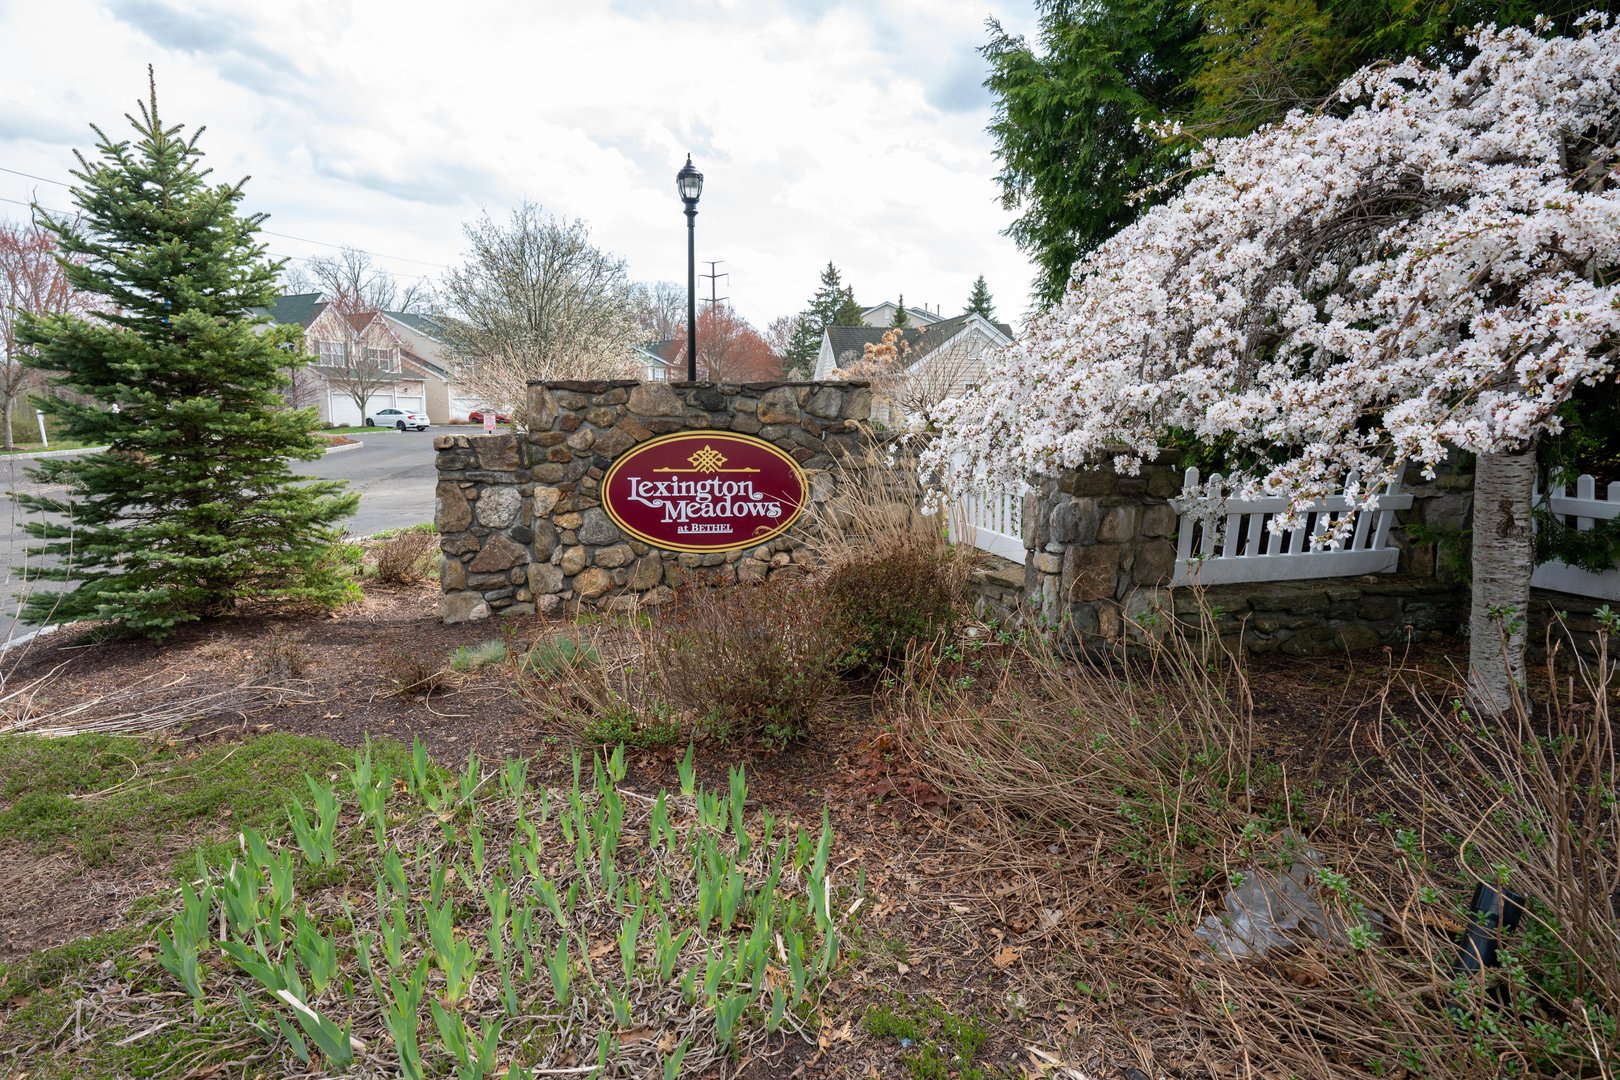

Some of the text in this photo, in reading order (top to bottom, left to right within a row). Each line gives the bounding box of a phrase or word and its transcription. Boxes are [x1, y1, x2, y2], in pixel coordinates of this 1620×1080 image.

[627, 475, 763, 508] Lexington
[661, 496, 782, 523] Meadows
[691, 523, 733, 532] BETHEL
